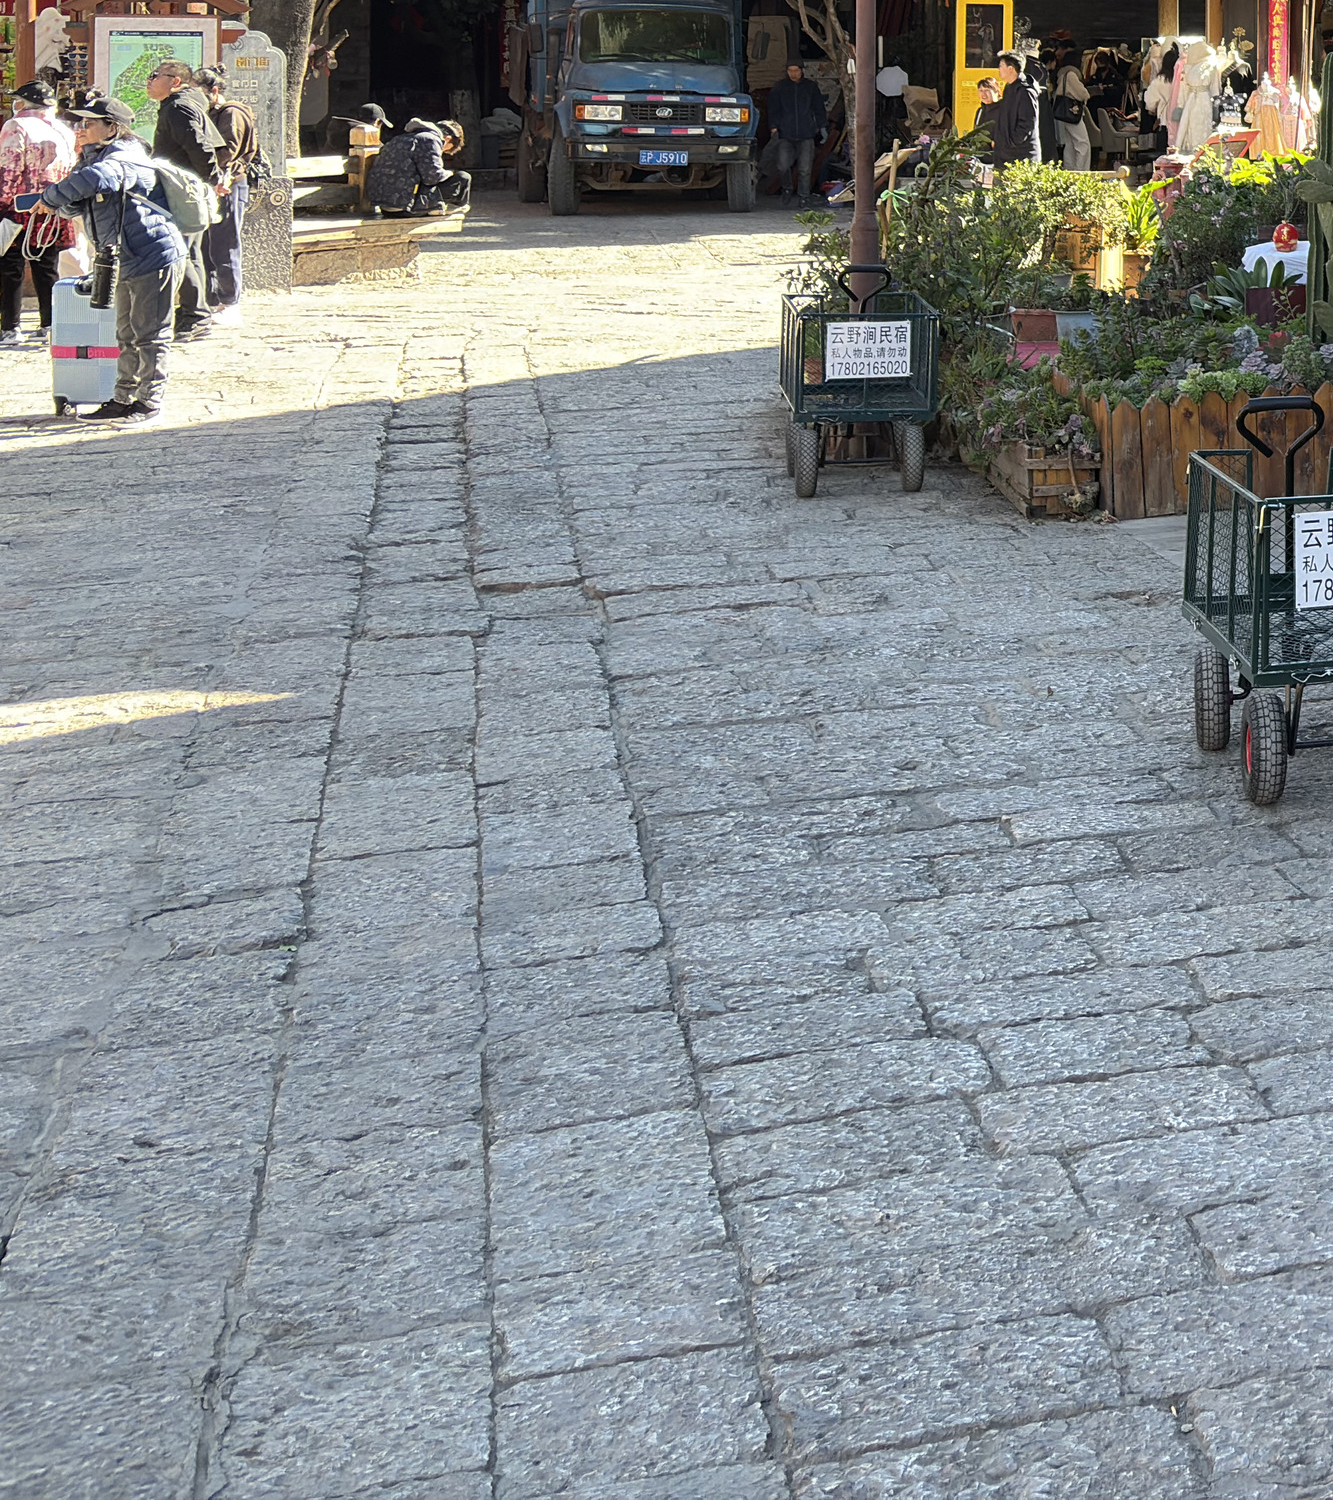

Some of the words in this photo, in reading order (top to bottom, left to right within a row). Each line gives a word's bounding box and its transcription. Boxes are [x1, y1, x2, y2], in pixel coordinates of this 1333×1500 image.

[655, 152, 687, 164] J5910
[830, 325, 908, 344] 云野涧民宿
[831, 346, 907, 359] 私人物品,请勿动
[831, 360, 908, 375] 17802165020
